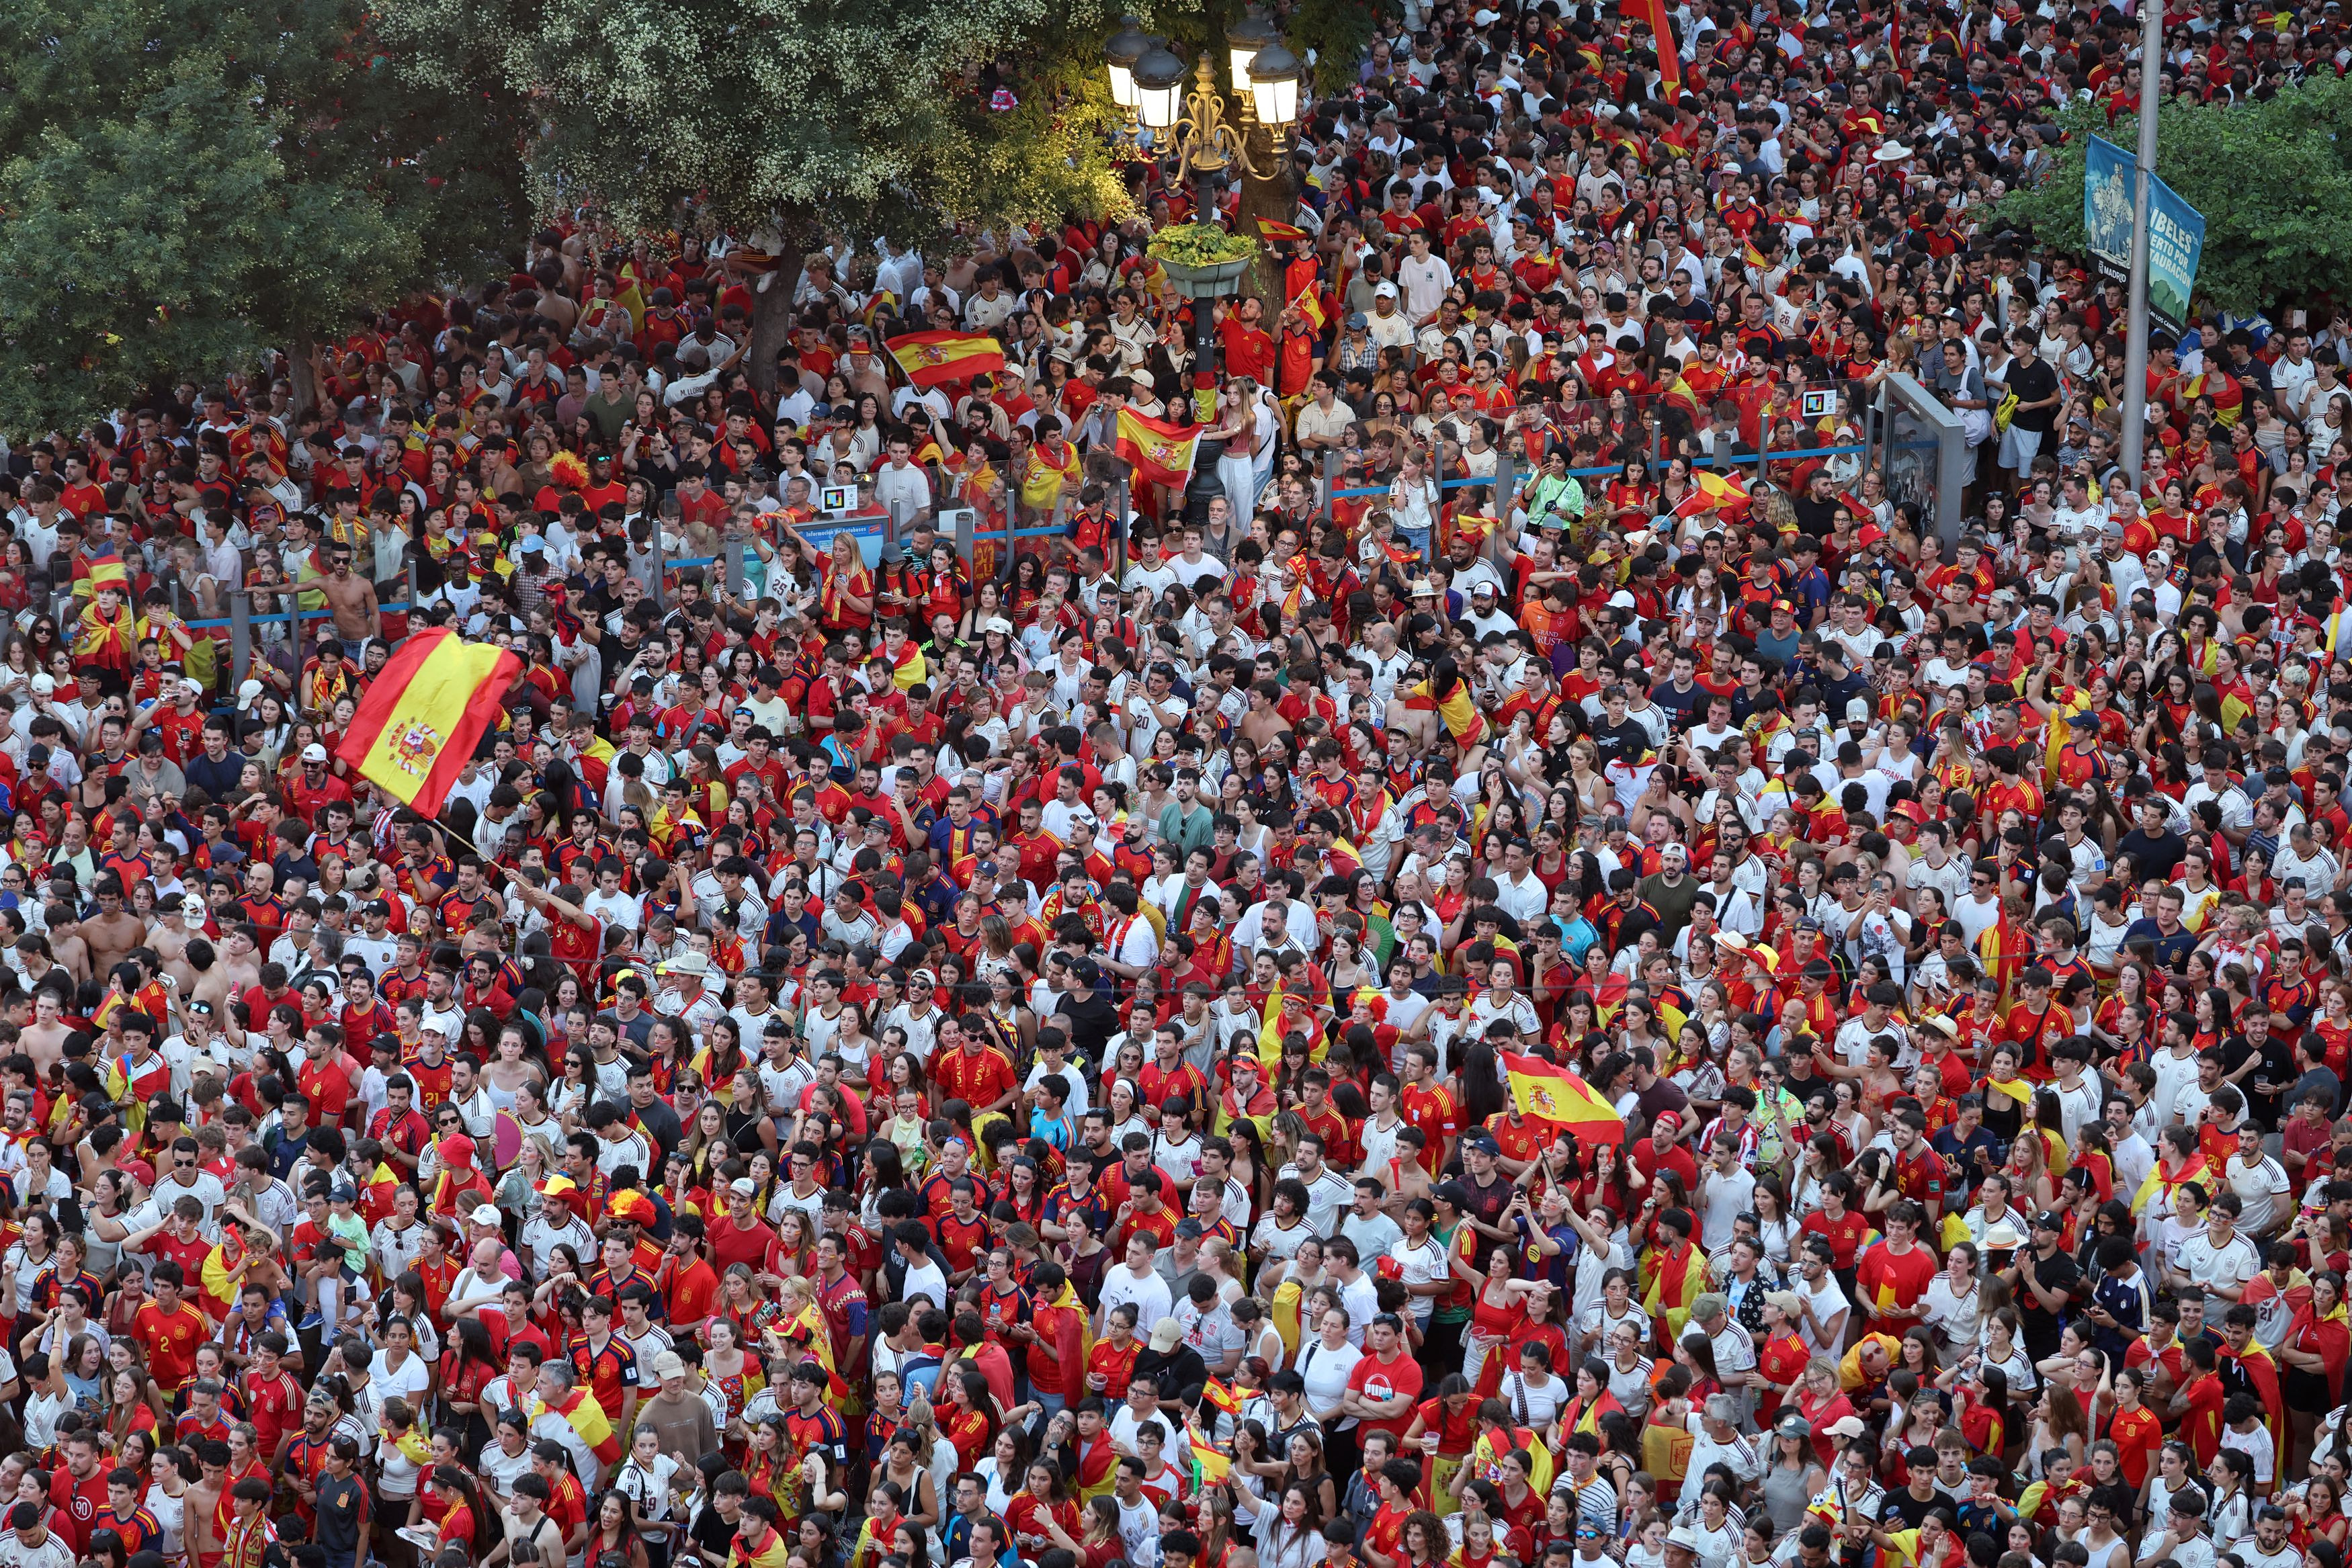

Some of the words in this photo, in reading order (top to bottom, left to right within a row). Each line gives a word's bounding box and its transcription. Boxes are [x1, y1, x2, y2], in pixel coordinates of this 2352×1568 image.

[2150, 232, 2174, 257] ERTO
[2175, 249, 2188, 269] POR
[2104, 266, 2126, 283] MADRID
[1780, 314, 1790, 324] 26
[2156, 314, 2164, 323] LOS
[2164, 320, 2180, 336] CAMINOS
[1347, 527, 1352, 539] 8
[771, 579, 788, 596] 25
[1536, 629, 1558, 637] GRAND
[1136, 715, 1149, 730] 20
[425, 1092, 439, 1107] 21
[2207, 1154, 2221, 1170] 20
[2260, 1307, 2272, 1322] 21
[160, 1336, 169, 1352] 2
[1188, 1328, 1203, 1346] 20
[76, 1501, 87, 1516] 90
